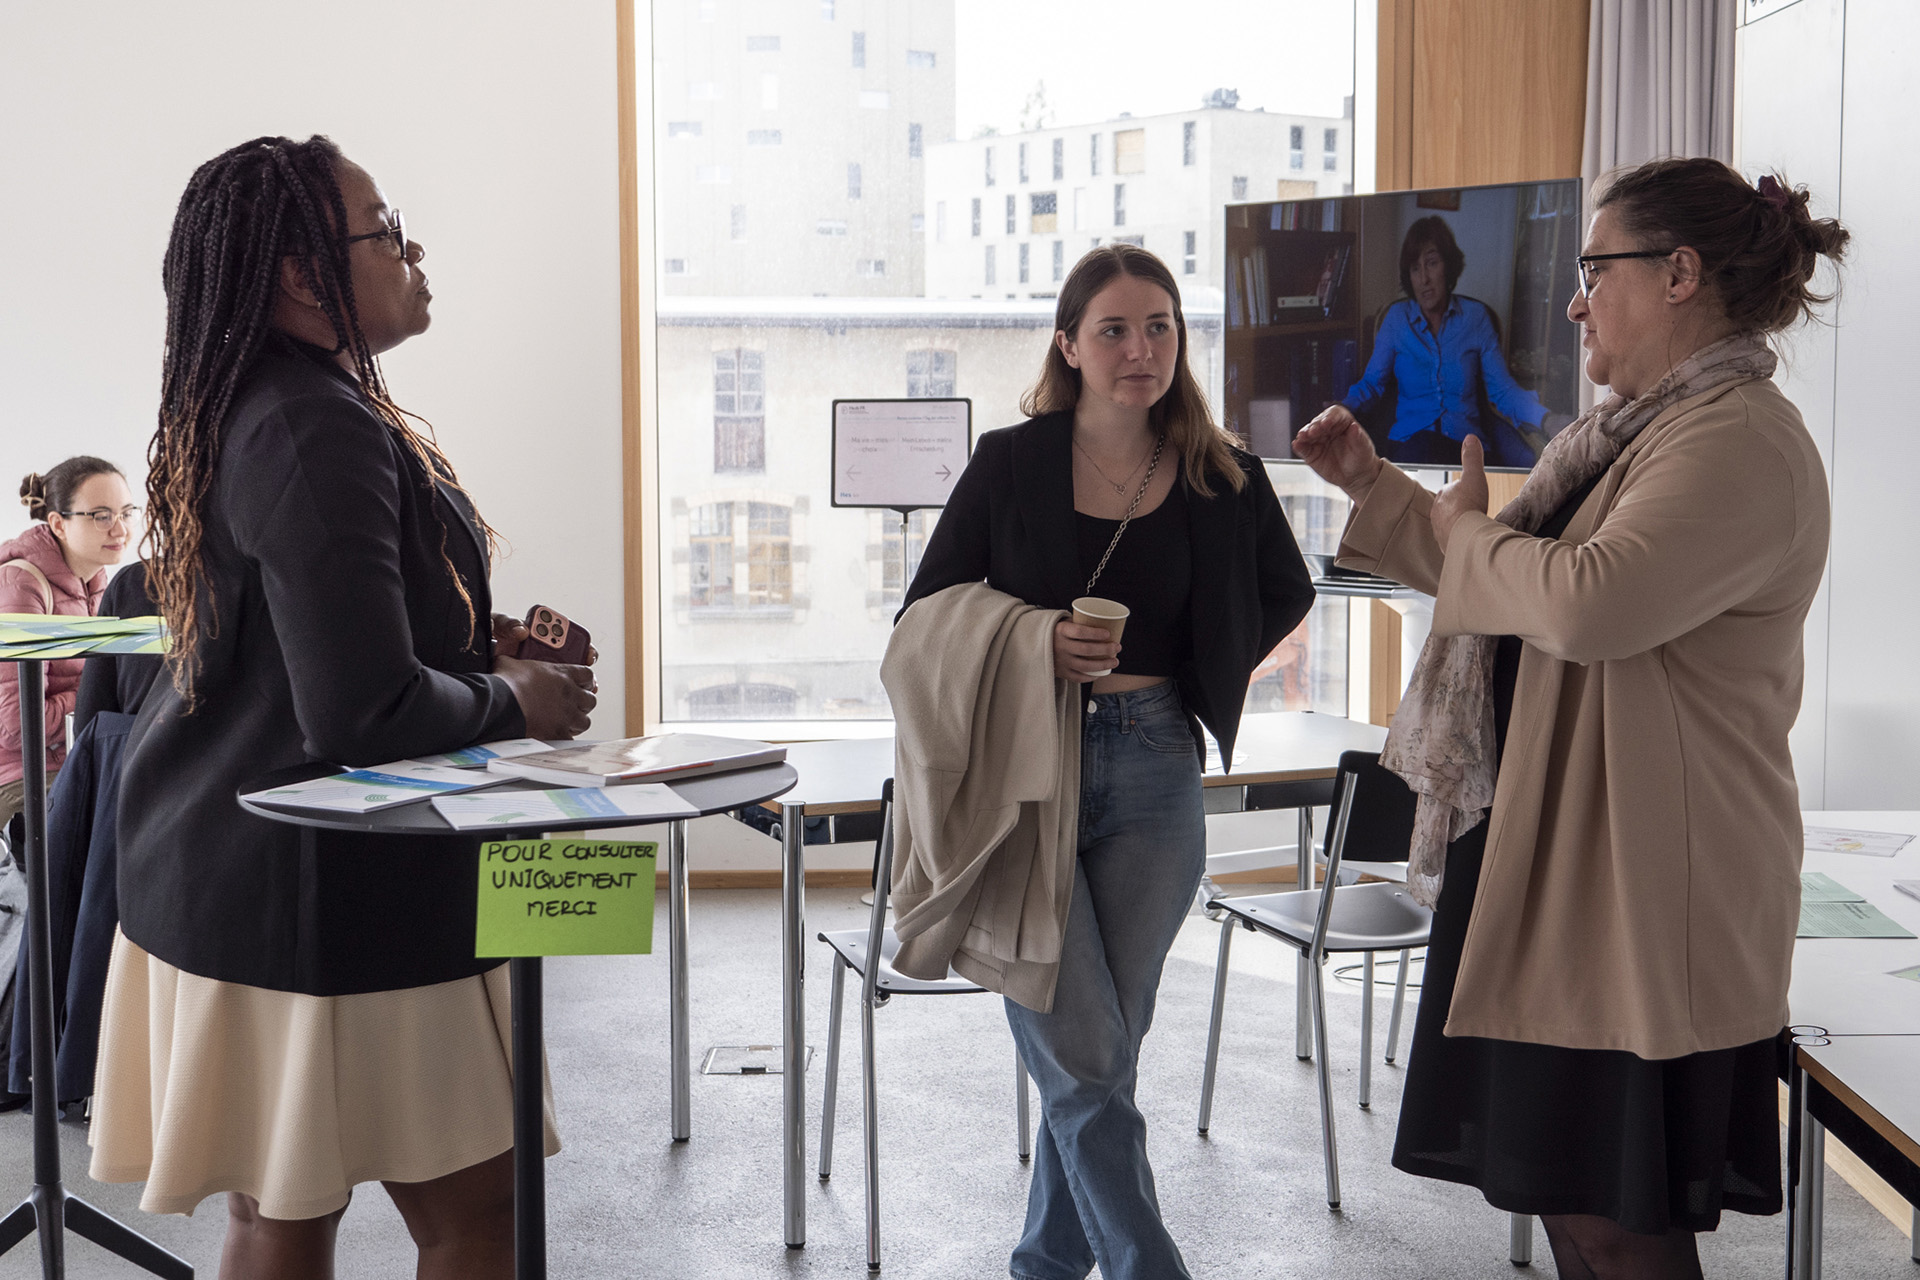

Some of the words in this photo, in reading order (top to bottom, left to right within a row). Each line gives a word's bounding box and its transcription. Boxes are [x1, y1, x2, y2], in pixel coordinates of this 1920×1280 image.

[487, 843, 552, 862] POUR
[562, 844, 655, 860] CONSULTER
[492, 868, 638, 890] UNIQUEMENT
[527, 900, 597, 917] MERCI
